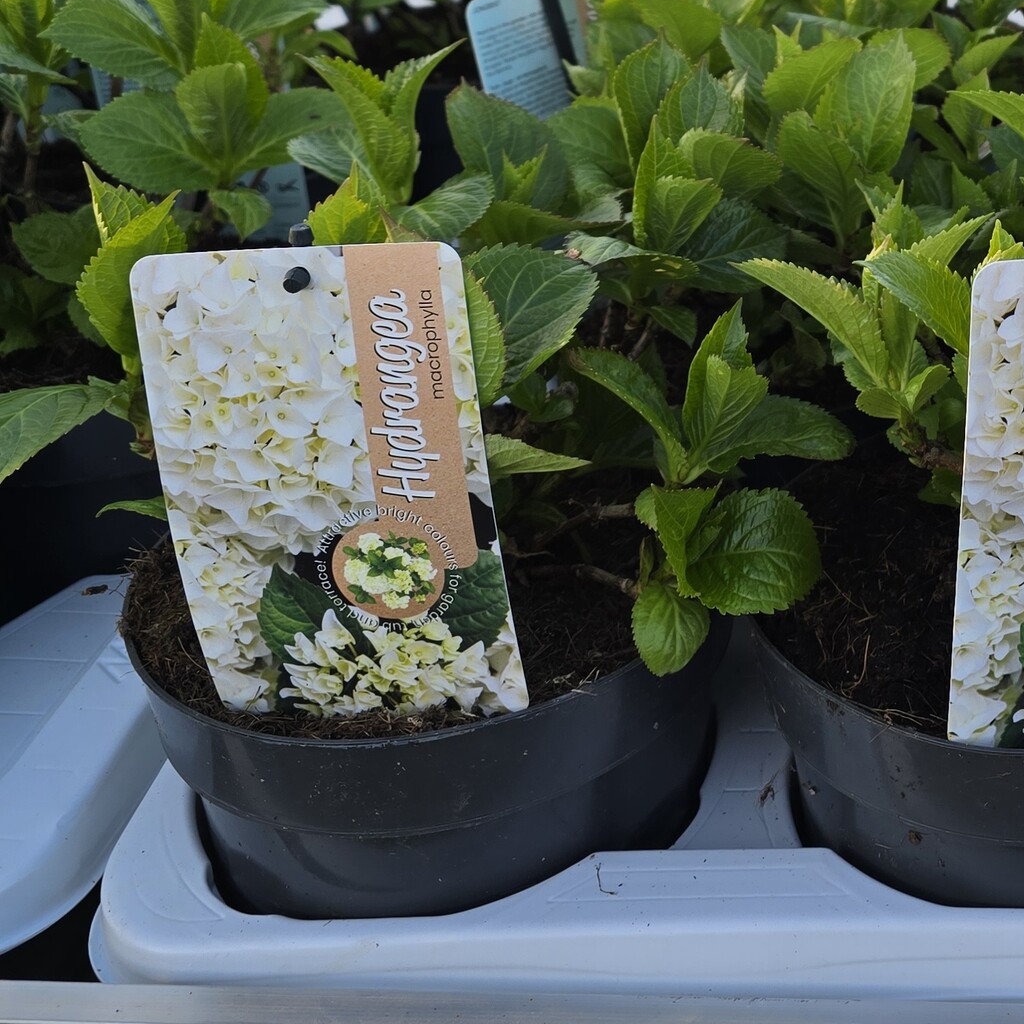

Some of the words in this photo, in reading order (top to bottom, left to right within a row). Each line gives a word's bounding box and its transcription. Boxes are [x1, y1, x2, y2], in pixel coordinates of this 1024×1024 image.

[418, 288, 445, 400] macrophylla
[369, 288, 441, 502] Hydrangea
[317, 507, 372, 553] Attractive
[376, 505, 423, 527] bright
[423, 523, 459, 571] colours
[315, 559, 347, 612] terrace!
[448, 574, 463, 594] for
[346, 610, 379, 629] and
[382, 622, 407, 632] tub
